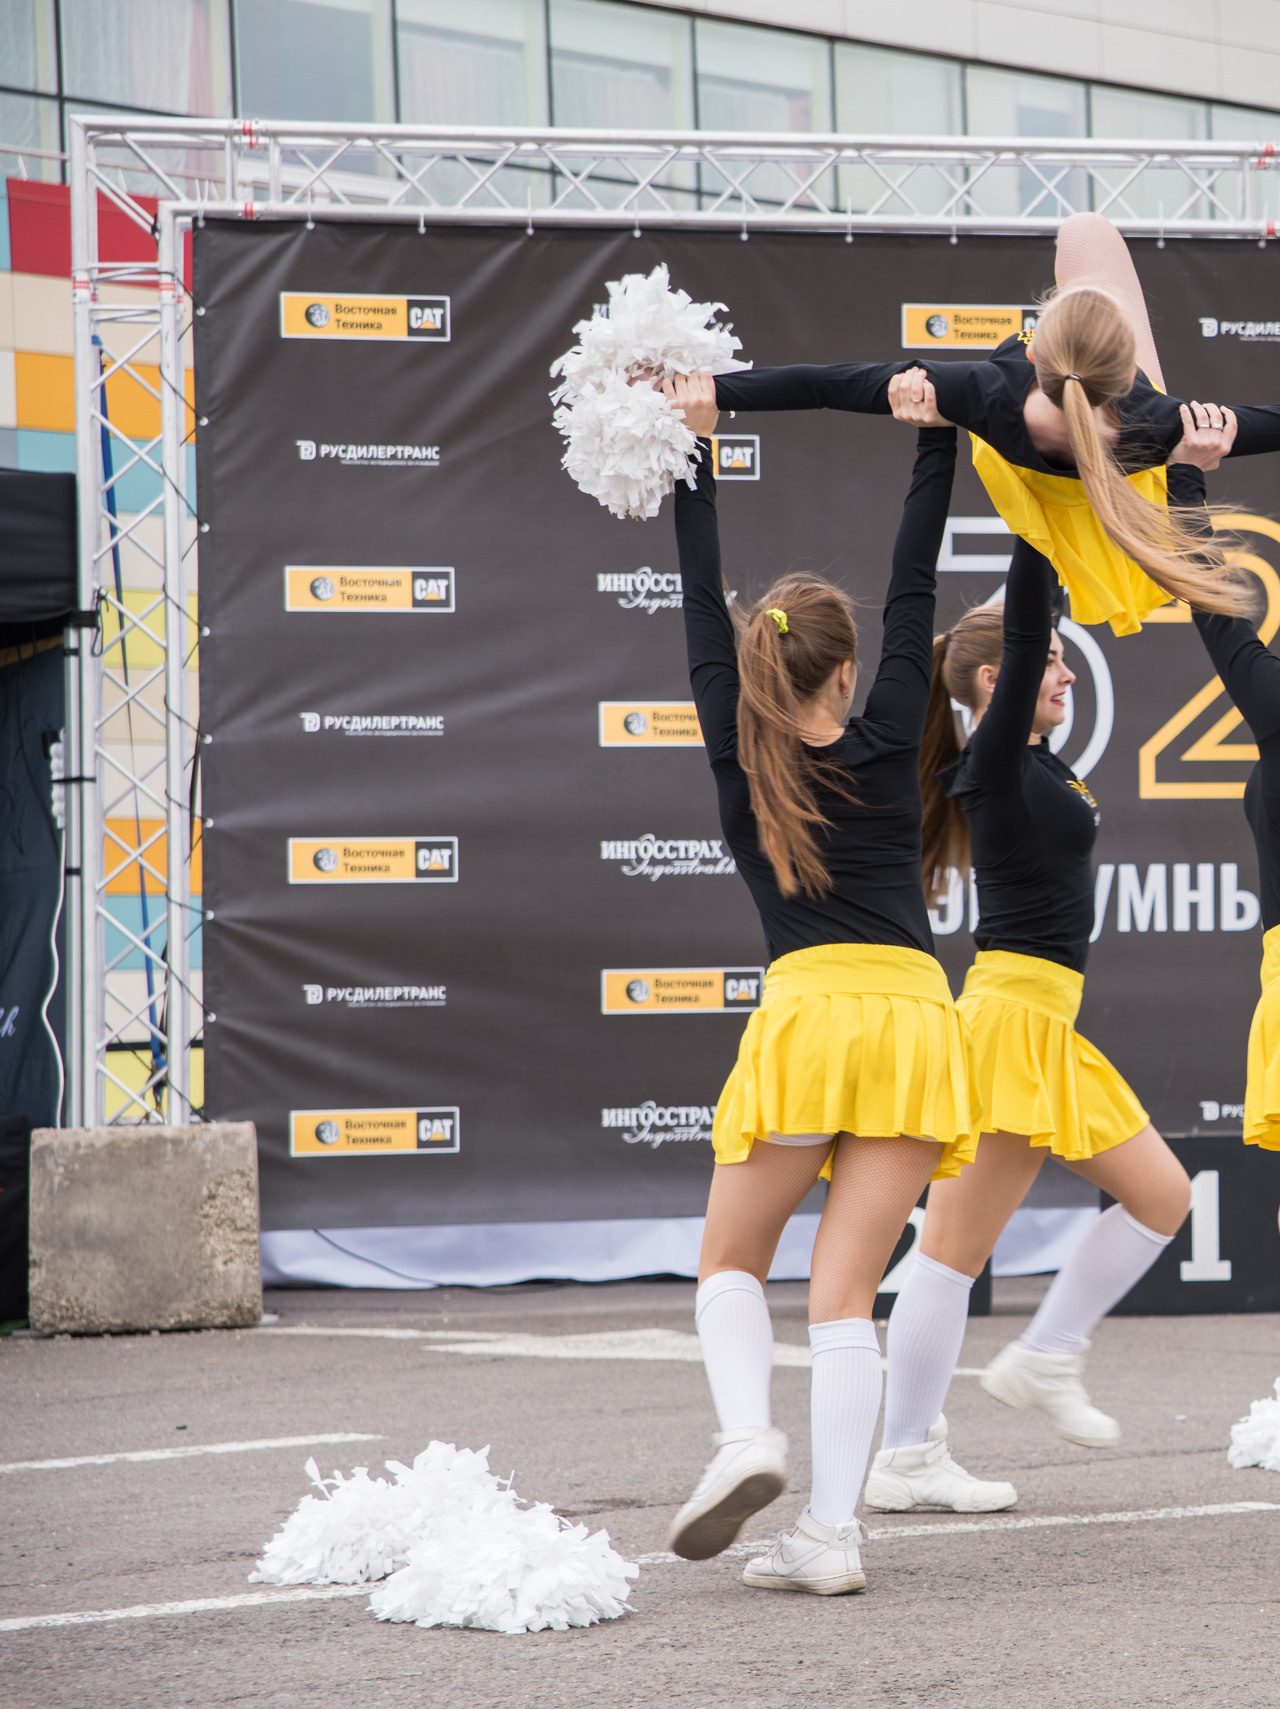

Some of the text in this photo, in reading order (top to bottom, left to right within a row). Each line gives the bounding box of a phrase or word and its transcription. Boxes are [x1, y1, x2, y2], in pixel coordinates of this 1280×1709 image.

[335, 303, 397, 316] Восточная
[409, 307, 444, 330] CAT
[953, 314, 1012, 326] Восточная
[335, 319, 383, 331] Техника
[953, 330, 998, 340] Техника
[320, 443, 440, 460] РУСДИЛЕРТРАНС
[720, 446, 754, 468] CAT
[340, 576, 402, 588] Восточная
[597, 571, 683, 592] ИНГОССТ
[414, 579, 449, 601] CAT
[340, 591, 388, 603] Техника
[324, 715, 444, 731] РУСДИЛЕРТРАНС
[653, 712, 699, 722] Восточн
[653, 726, 698, 737] Техника
[343, 847, 405, 859] Восточная
[600, 838, 722, 859] ИНГОССТРАХ
[417, 848, 452, 871] CAT
[343, 862, 391, 873] Техника
[654, 977, 714, 989] Восточная
[725, 978, 759, 1000] CAT
[326, 985, 446, 1002] РУСДИЛЕРТРАНС
[654, 993, 700, 1004] Техника
[345, 1118, 407, 1130] Восточная
[419, 1119, 454, 1142] CAT
[345, 1134, 392, 1145] Техника
[1180, 1169, 1232, 1282] 1
